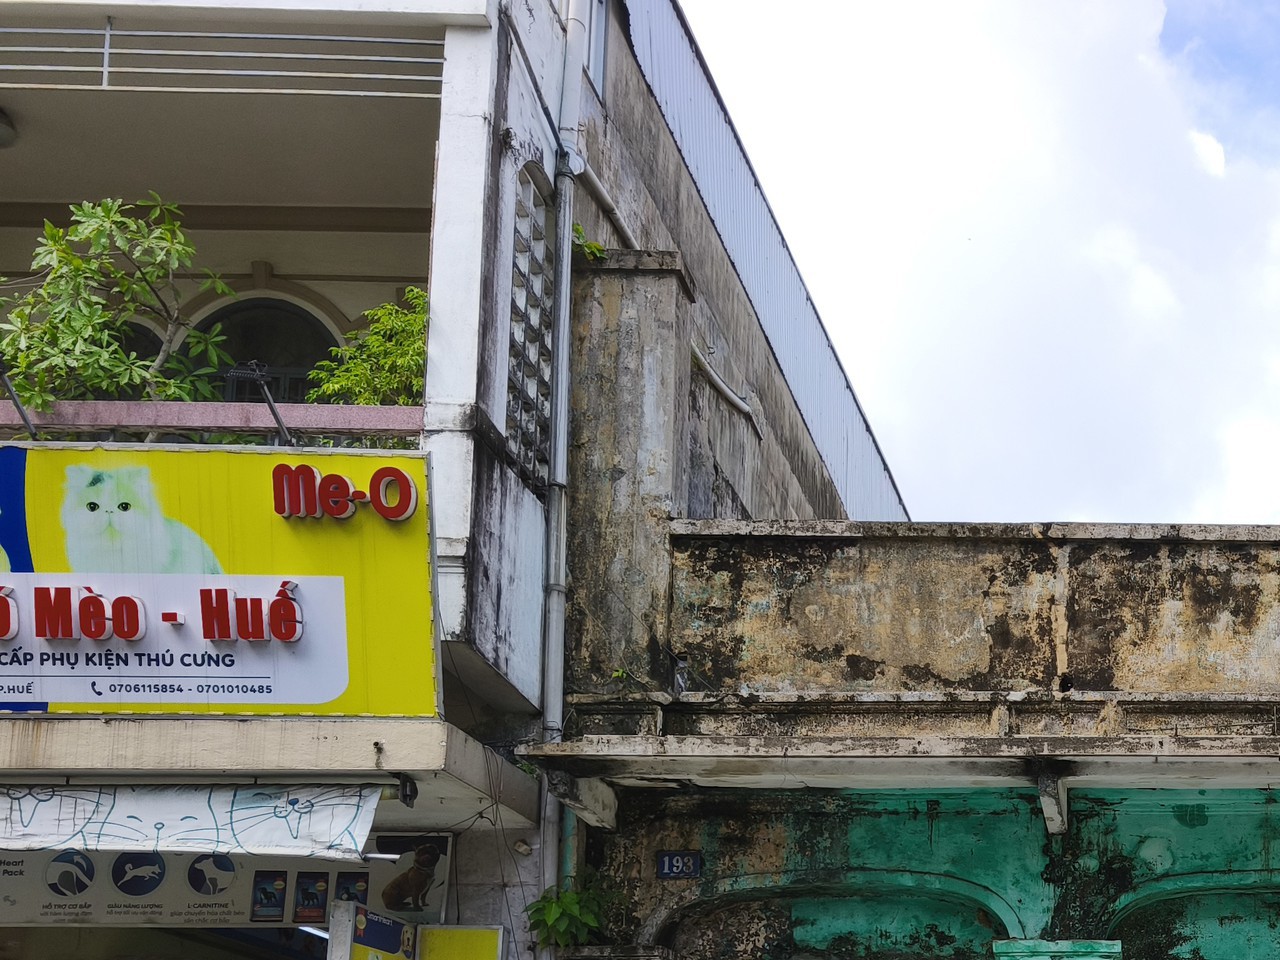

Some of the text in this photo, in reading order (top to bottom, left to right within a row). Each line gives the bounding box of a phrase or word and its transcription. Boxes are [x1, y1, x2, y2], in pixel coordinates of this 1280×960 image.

[272, 463, 415, 519] Me-O
[34, 585, 141, 639] Mèo
[161, 612, 182, 623] -
[200, 581, 300, 641] Huế
[0, 646, 235, 670] CẤP PHỤ KIỆN THÚ CƯNG
[109, 683, 184, 694] 0706115854
[196, 684, 272, 694] 0701010485
[663, 856, 693, 873] 193
